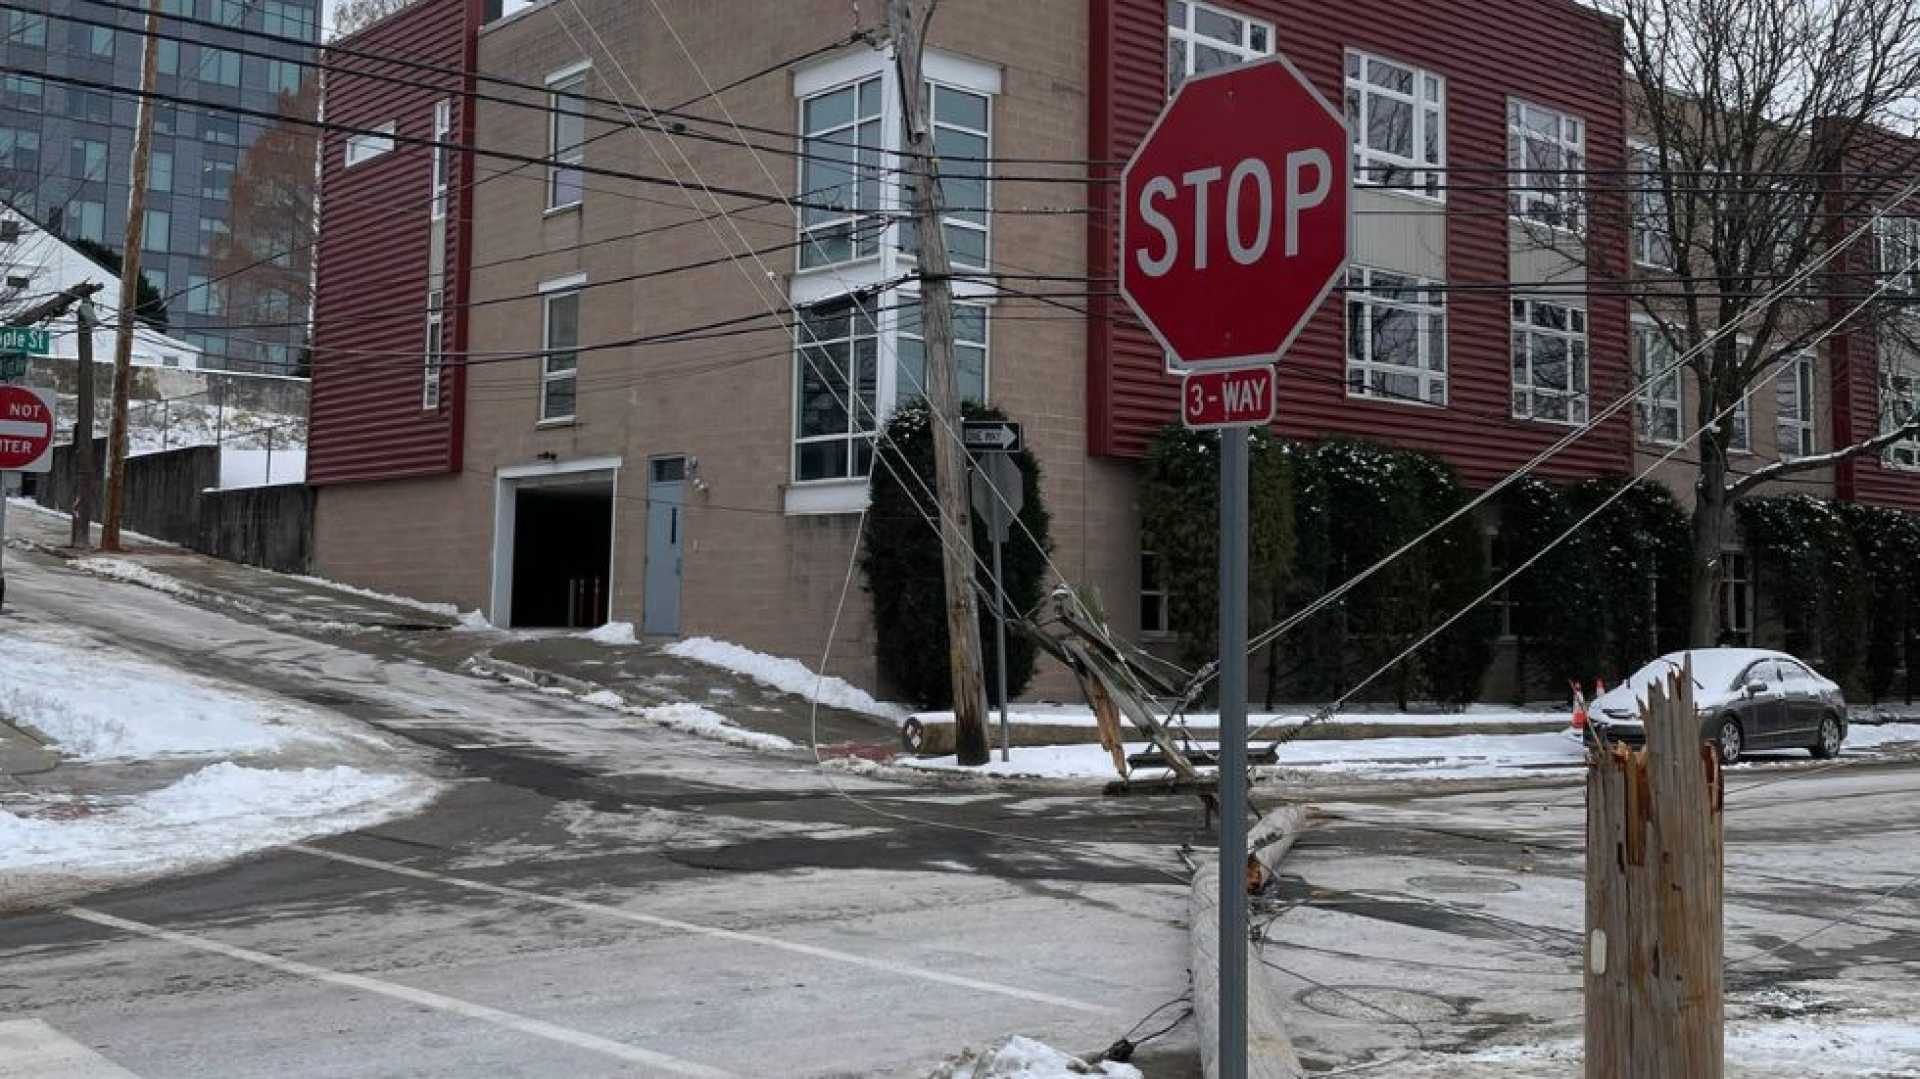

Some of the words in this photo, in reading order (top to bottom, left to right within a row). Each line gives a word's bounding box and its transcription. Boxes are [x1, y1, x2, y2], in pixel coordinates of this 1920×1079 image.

[1136, 148, 1333, 278] STOP
[0, 329, 25, 350] ple
[28, 331, 43, 350] St
[9, 403, 41, 418] NOT
[1190, 377, 1267, 416] 3-WAY
